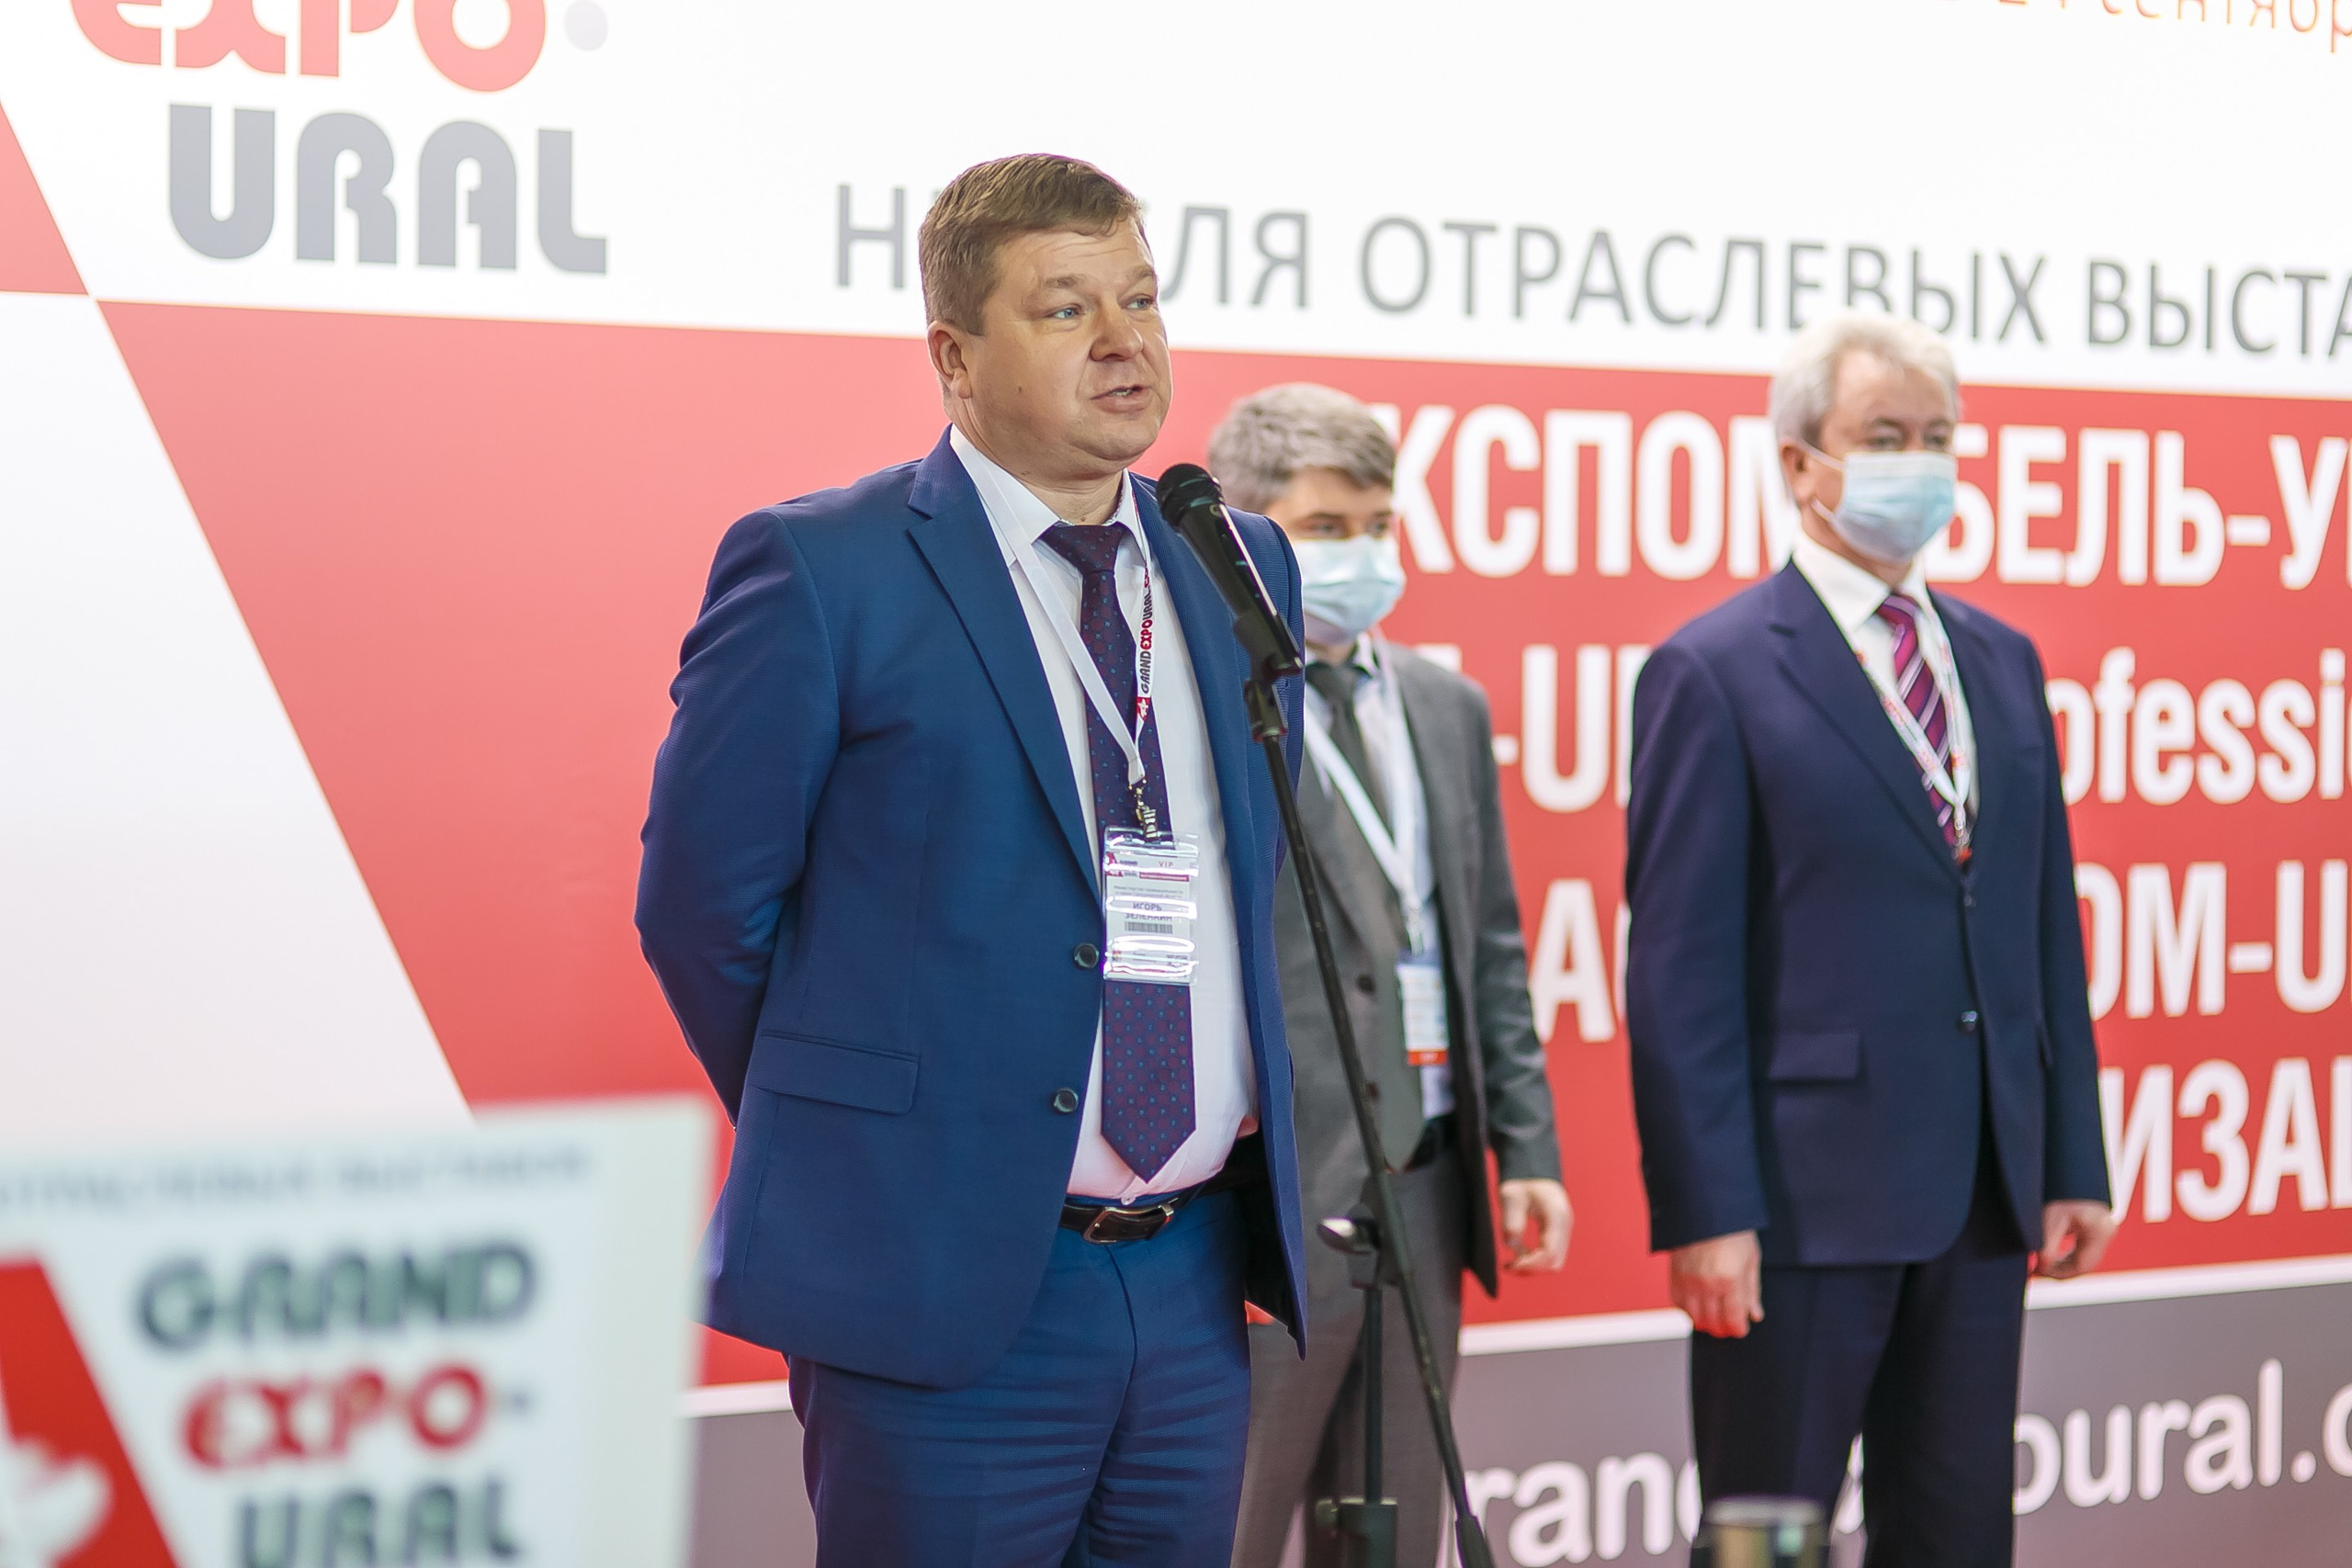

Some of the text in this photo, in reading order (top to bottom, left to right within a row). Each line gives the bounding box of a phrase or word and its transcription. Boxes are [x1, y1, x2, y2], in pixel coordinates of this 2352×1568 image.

[168, 103, 608, 276] URAL
[836, 183, 1310, 309] НЛЯ
[1360, 215, 2047, 344] ОТРАСЛЕВЫХ
[1133, 902, 1163, 912] ИГОРЬ
[136, 1240, 540, 1350] GRAND
